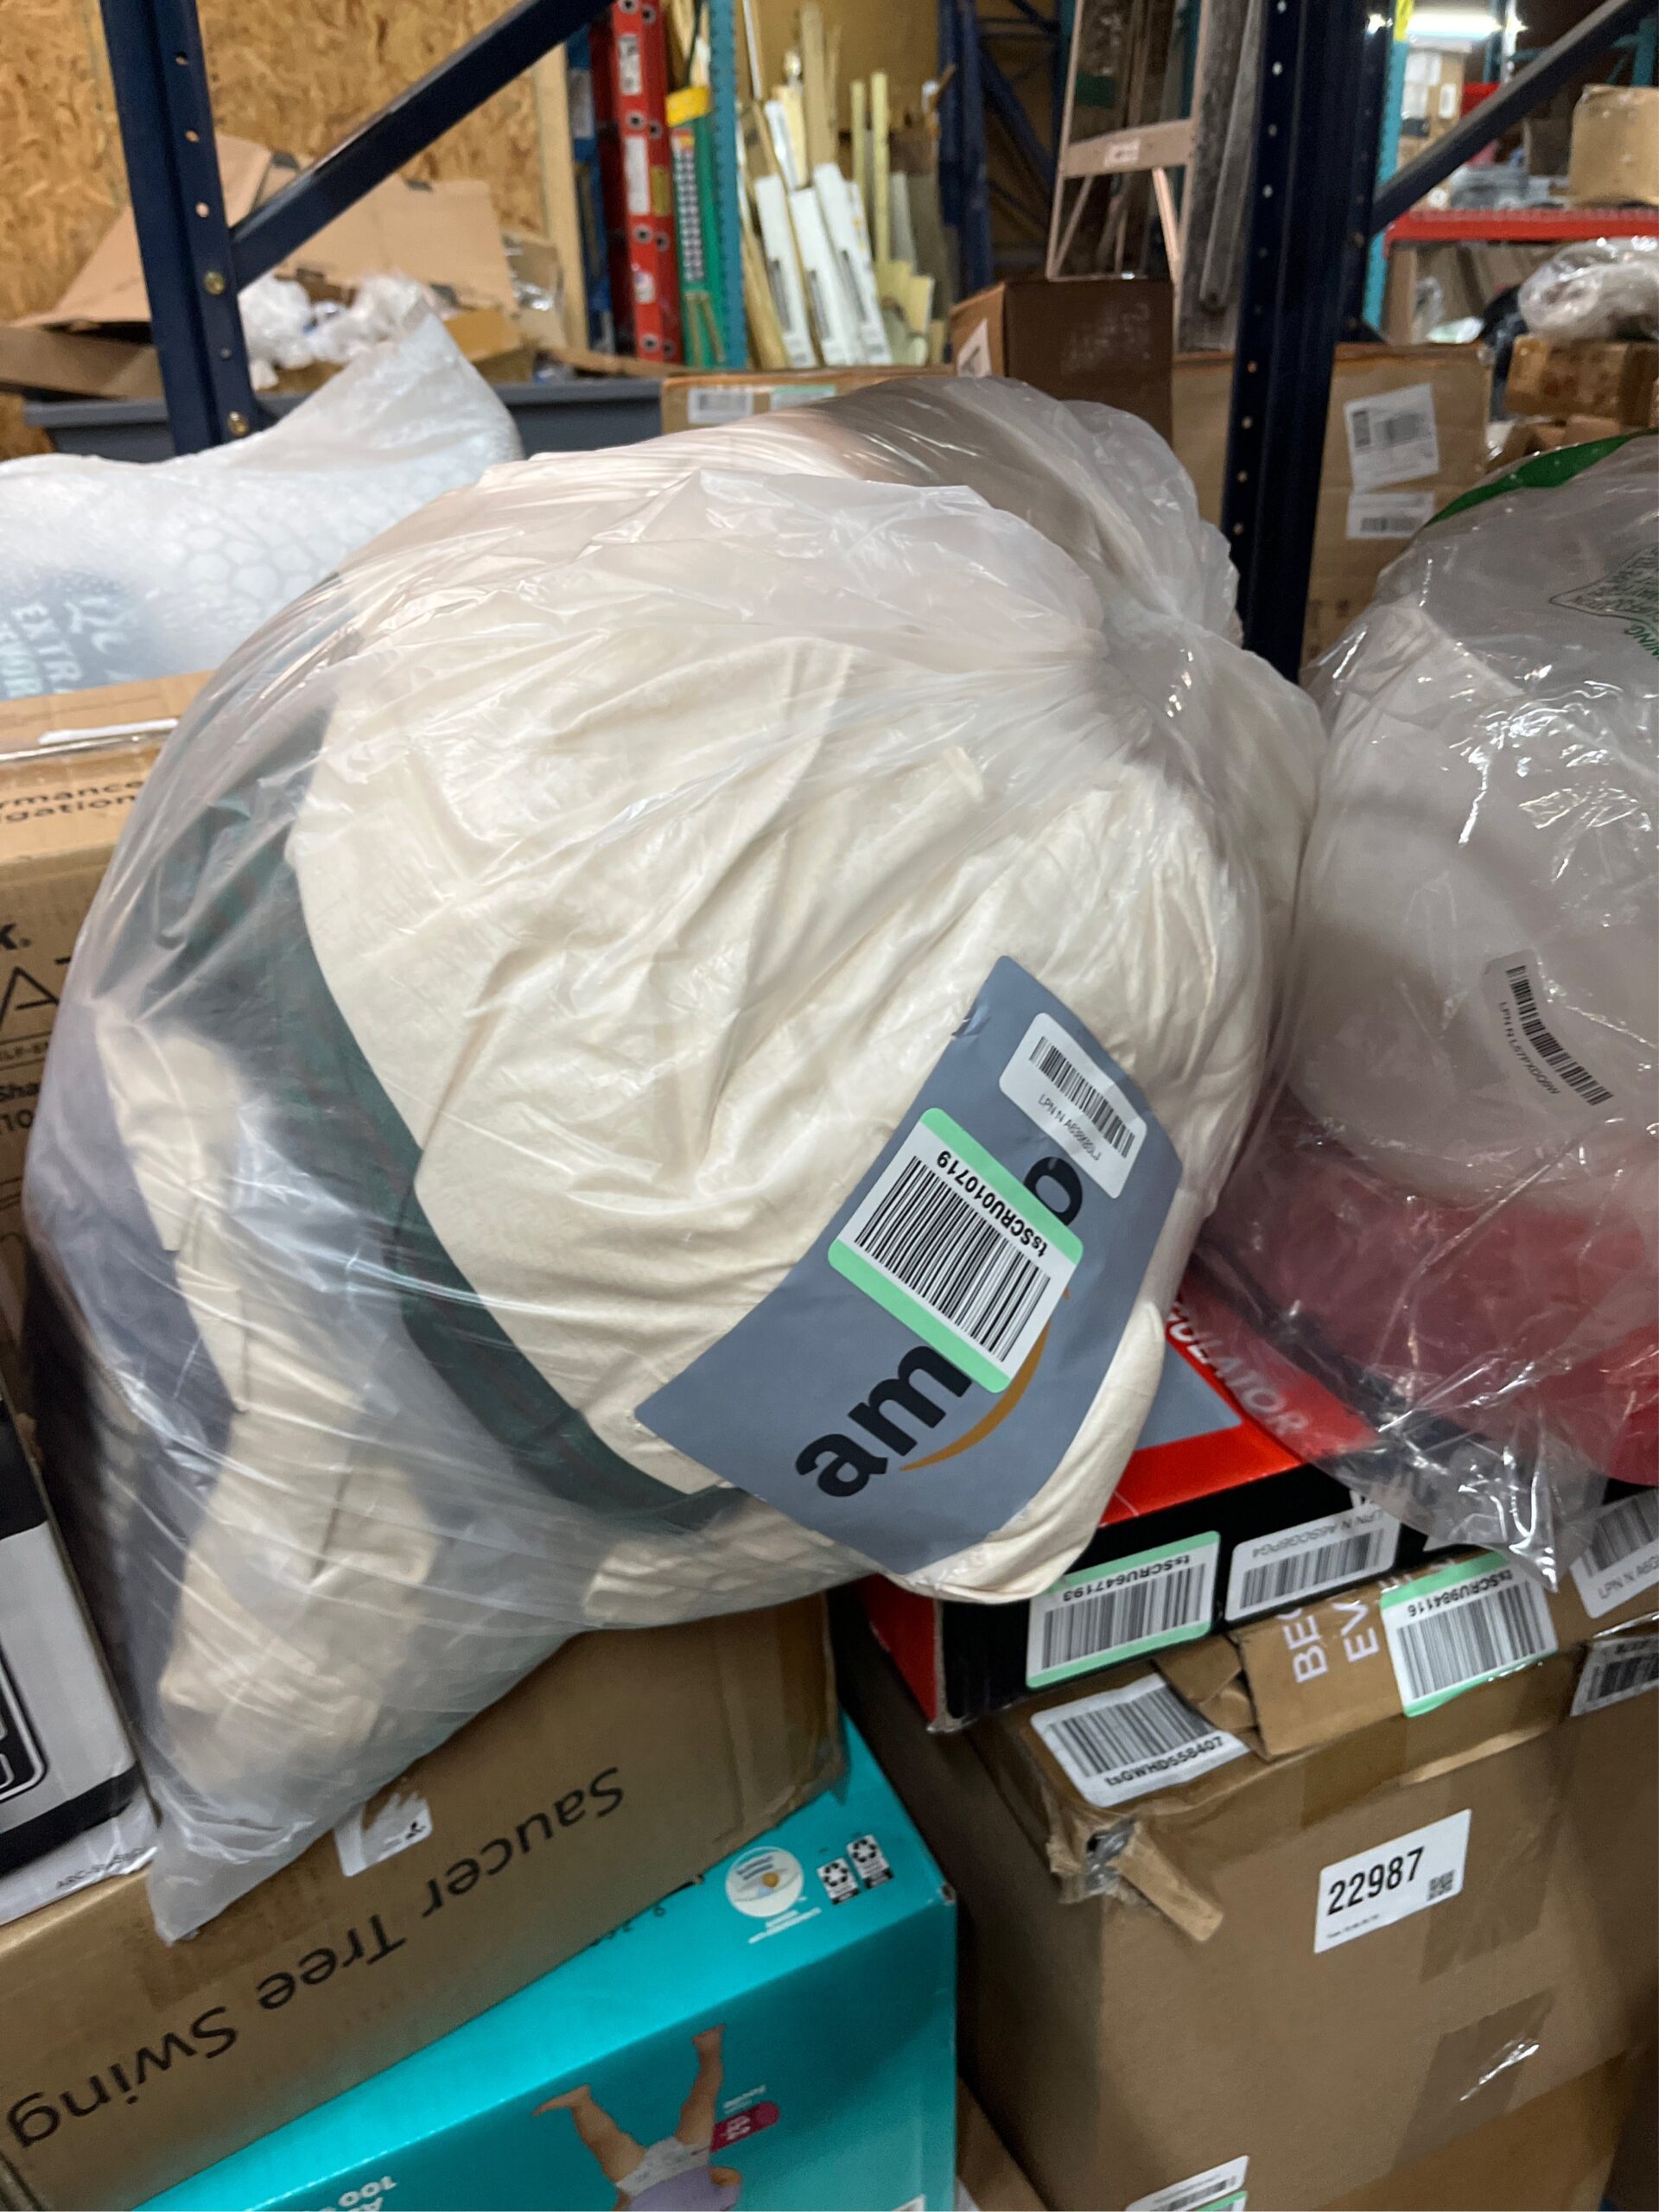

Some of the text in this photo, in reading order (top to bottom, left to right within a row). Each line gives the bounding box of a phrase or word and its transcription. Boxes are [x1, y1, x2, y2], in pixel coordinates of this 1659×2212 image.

[937, 1150, 1048, 1258] tsSCRU010719
[1062, 1554, 1190, 1602] tsSCRU647193
[1327, 1845, 1425, 1916] 22987
[6, 1766, 624, 2148] Saucer Tree Swing
[337, 2175, 398, 2208] 100
